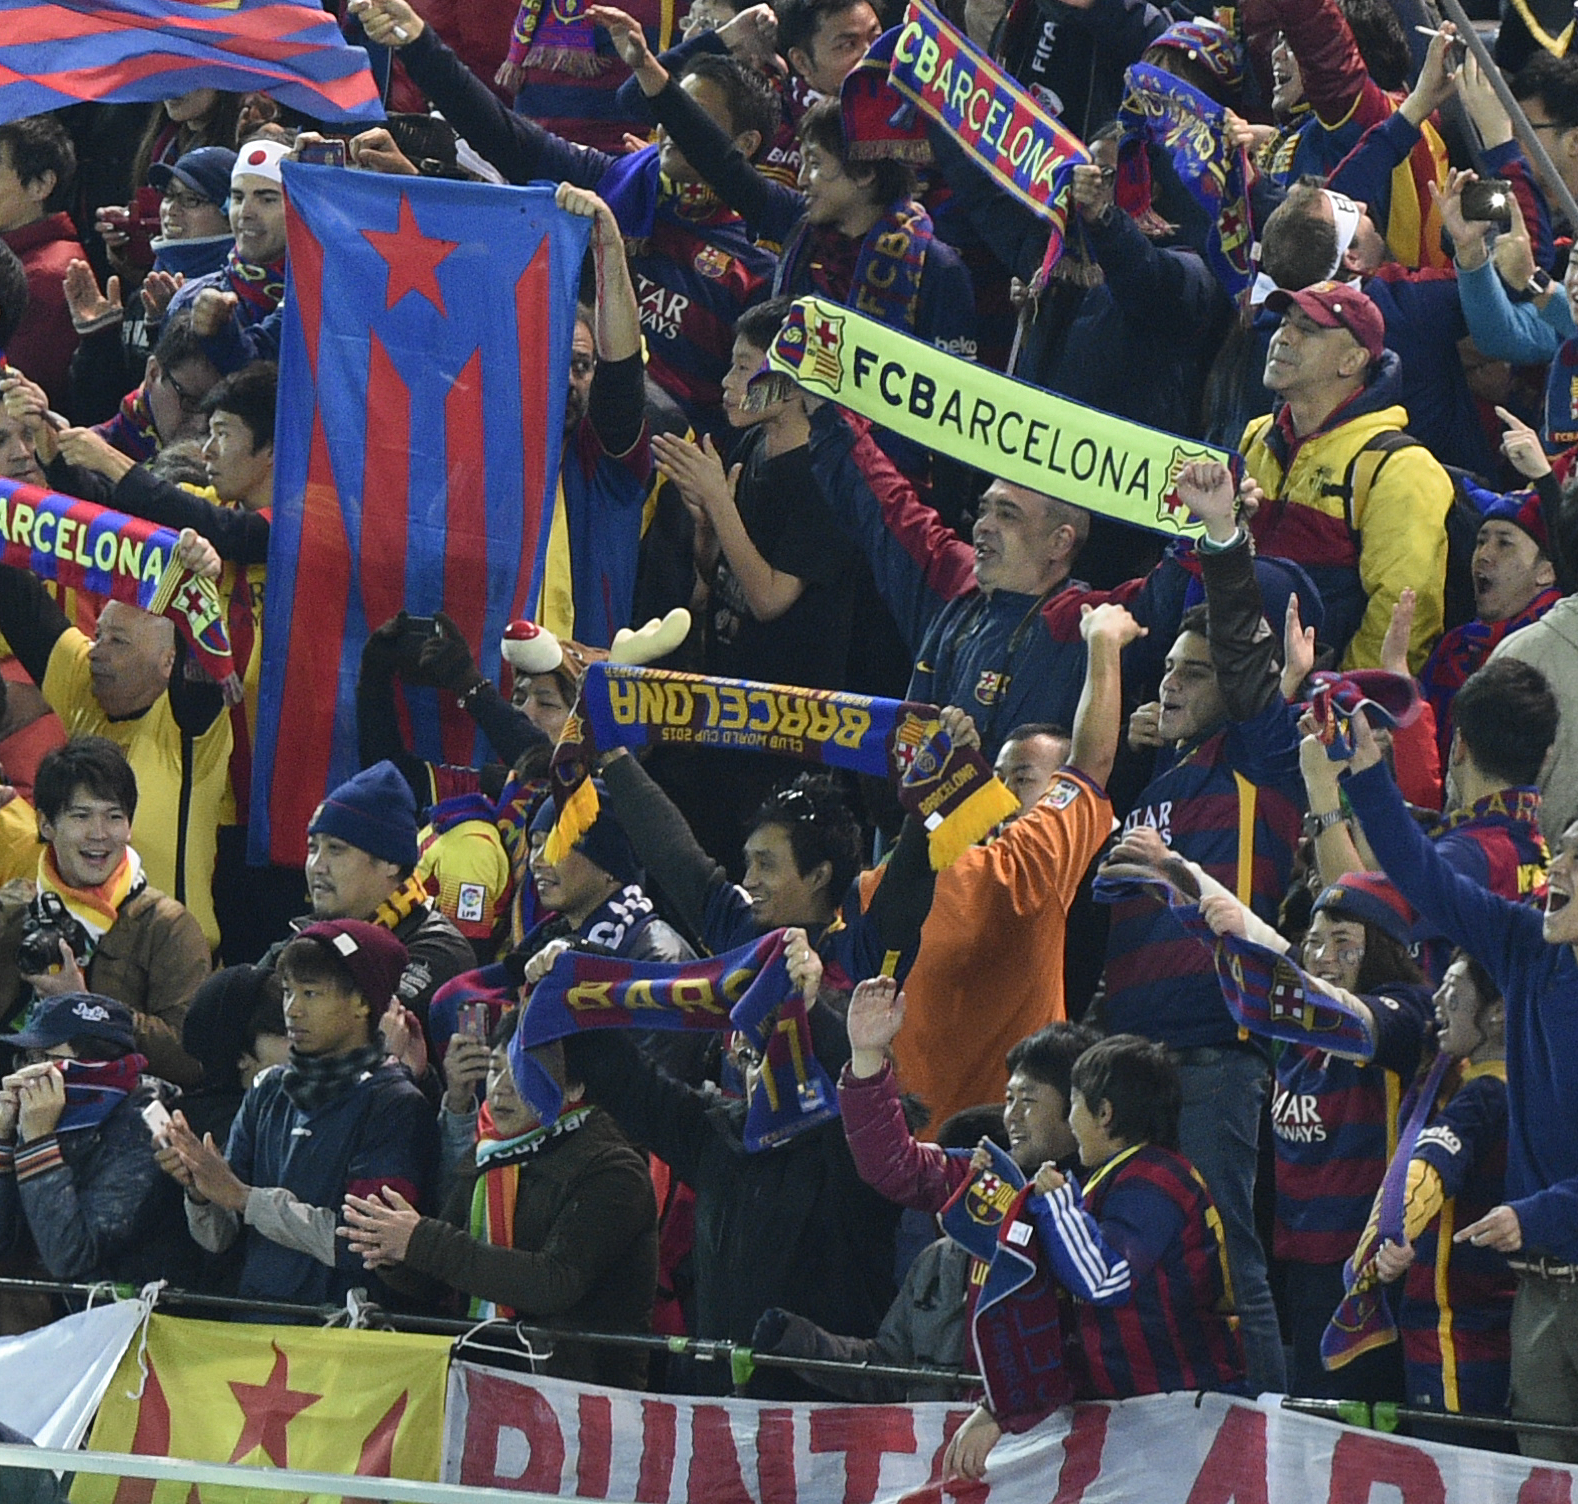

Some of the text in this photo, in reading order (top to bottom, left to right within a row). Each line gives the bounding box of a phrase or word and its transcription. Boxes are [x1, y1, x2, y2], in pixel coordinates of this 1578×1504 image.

[1032, 19, 1059, 73] FIFA
[894, 22, 1059, 194] CBARCELONA
[637, 273, 689, 324] TAR
[852, 343, 1151, 501] FCBARCELONA
[608, 679, 872, 750] BARCELONA
[662, 726, 804, 754] CLUB WORLD CUP 2015
[918, 762, 978, 817] BARCELONA
[1122, 800, 1173, 834] ATAR
